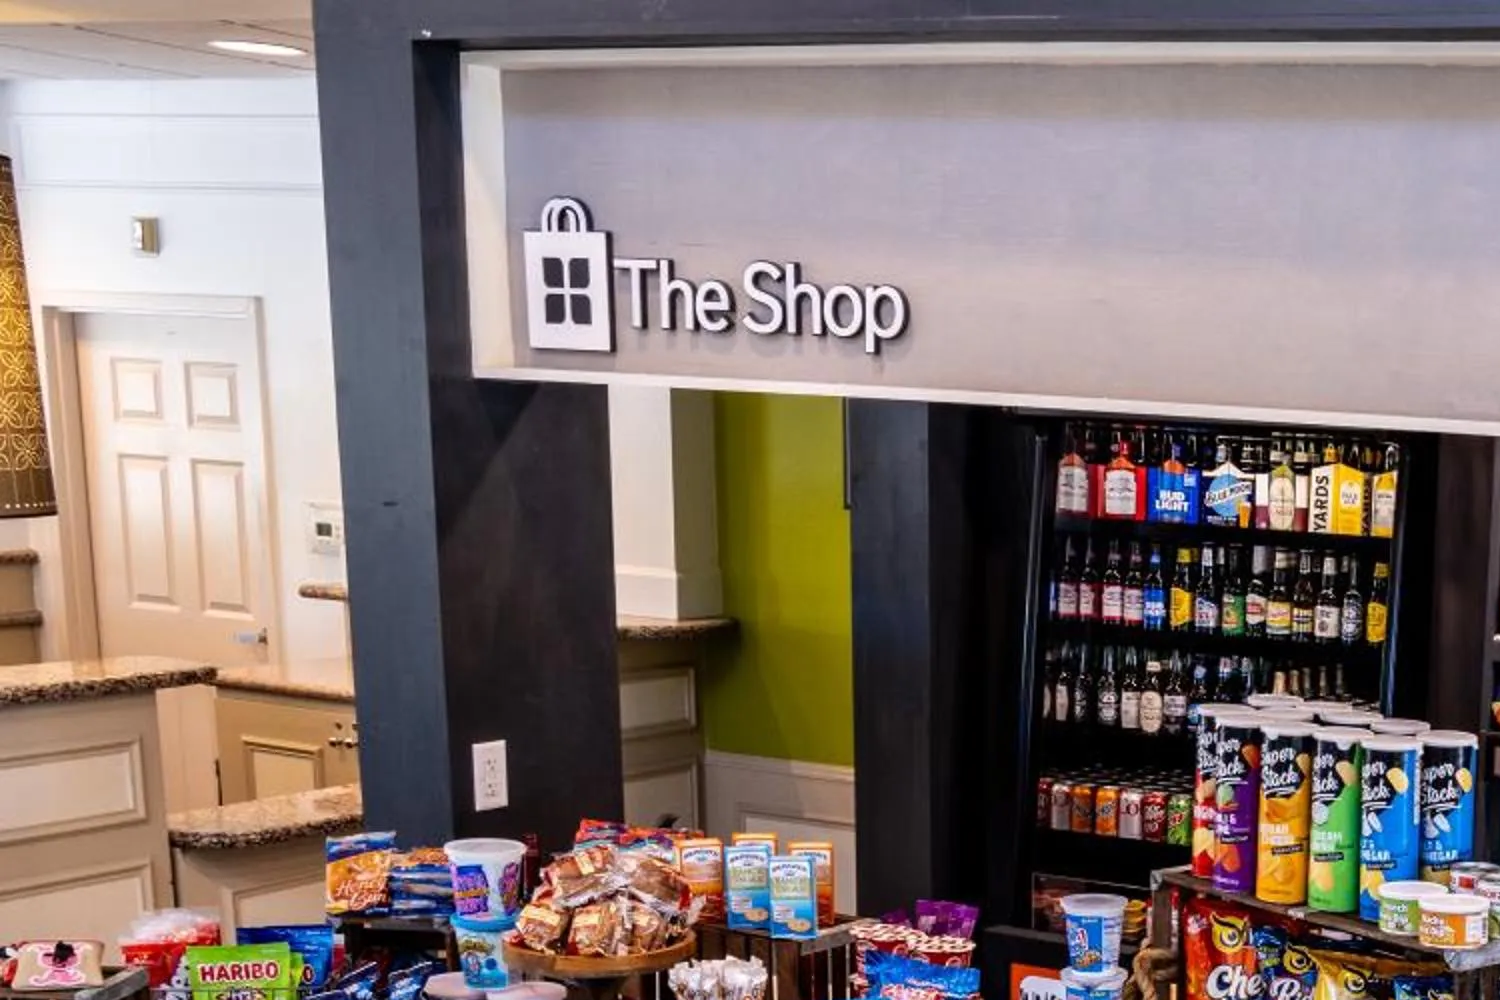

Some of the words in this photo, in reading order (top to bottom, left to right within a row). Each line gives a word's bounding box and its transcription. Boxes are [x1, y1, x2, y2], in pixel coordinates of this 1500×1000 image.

[613, 258, 734, 333] The
[741, 260, 908, 353] Shop
[1155, 500, 1189, 512] LIGHT
[1160, 489, 1185, 501] BUD
[1313, 475, 1329, 532] YARDS
[199, 961, 280, 983] HARIBO
